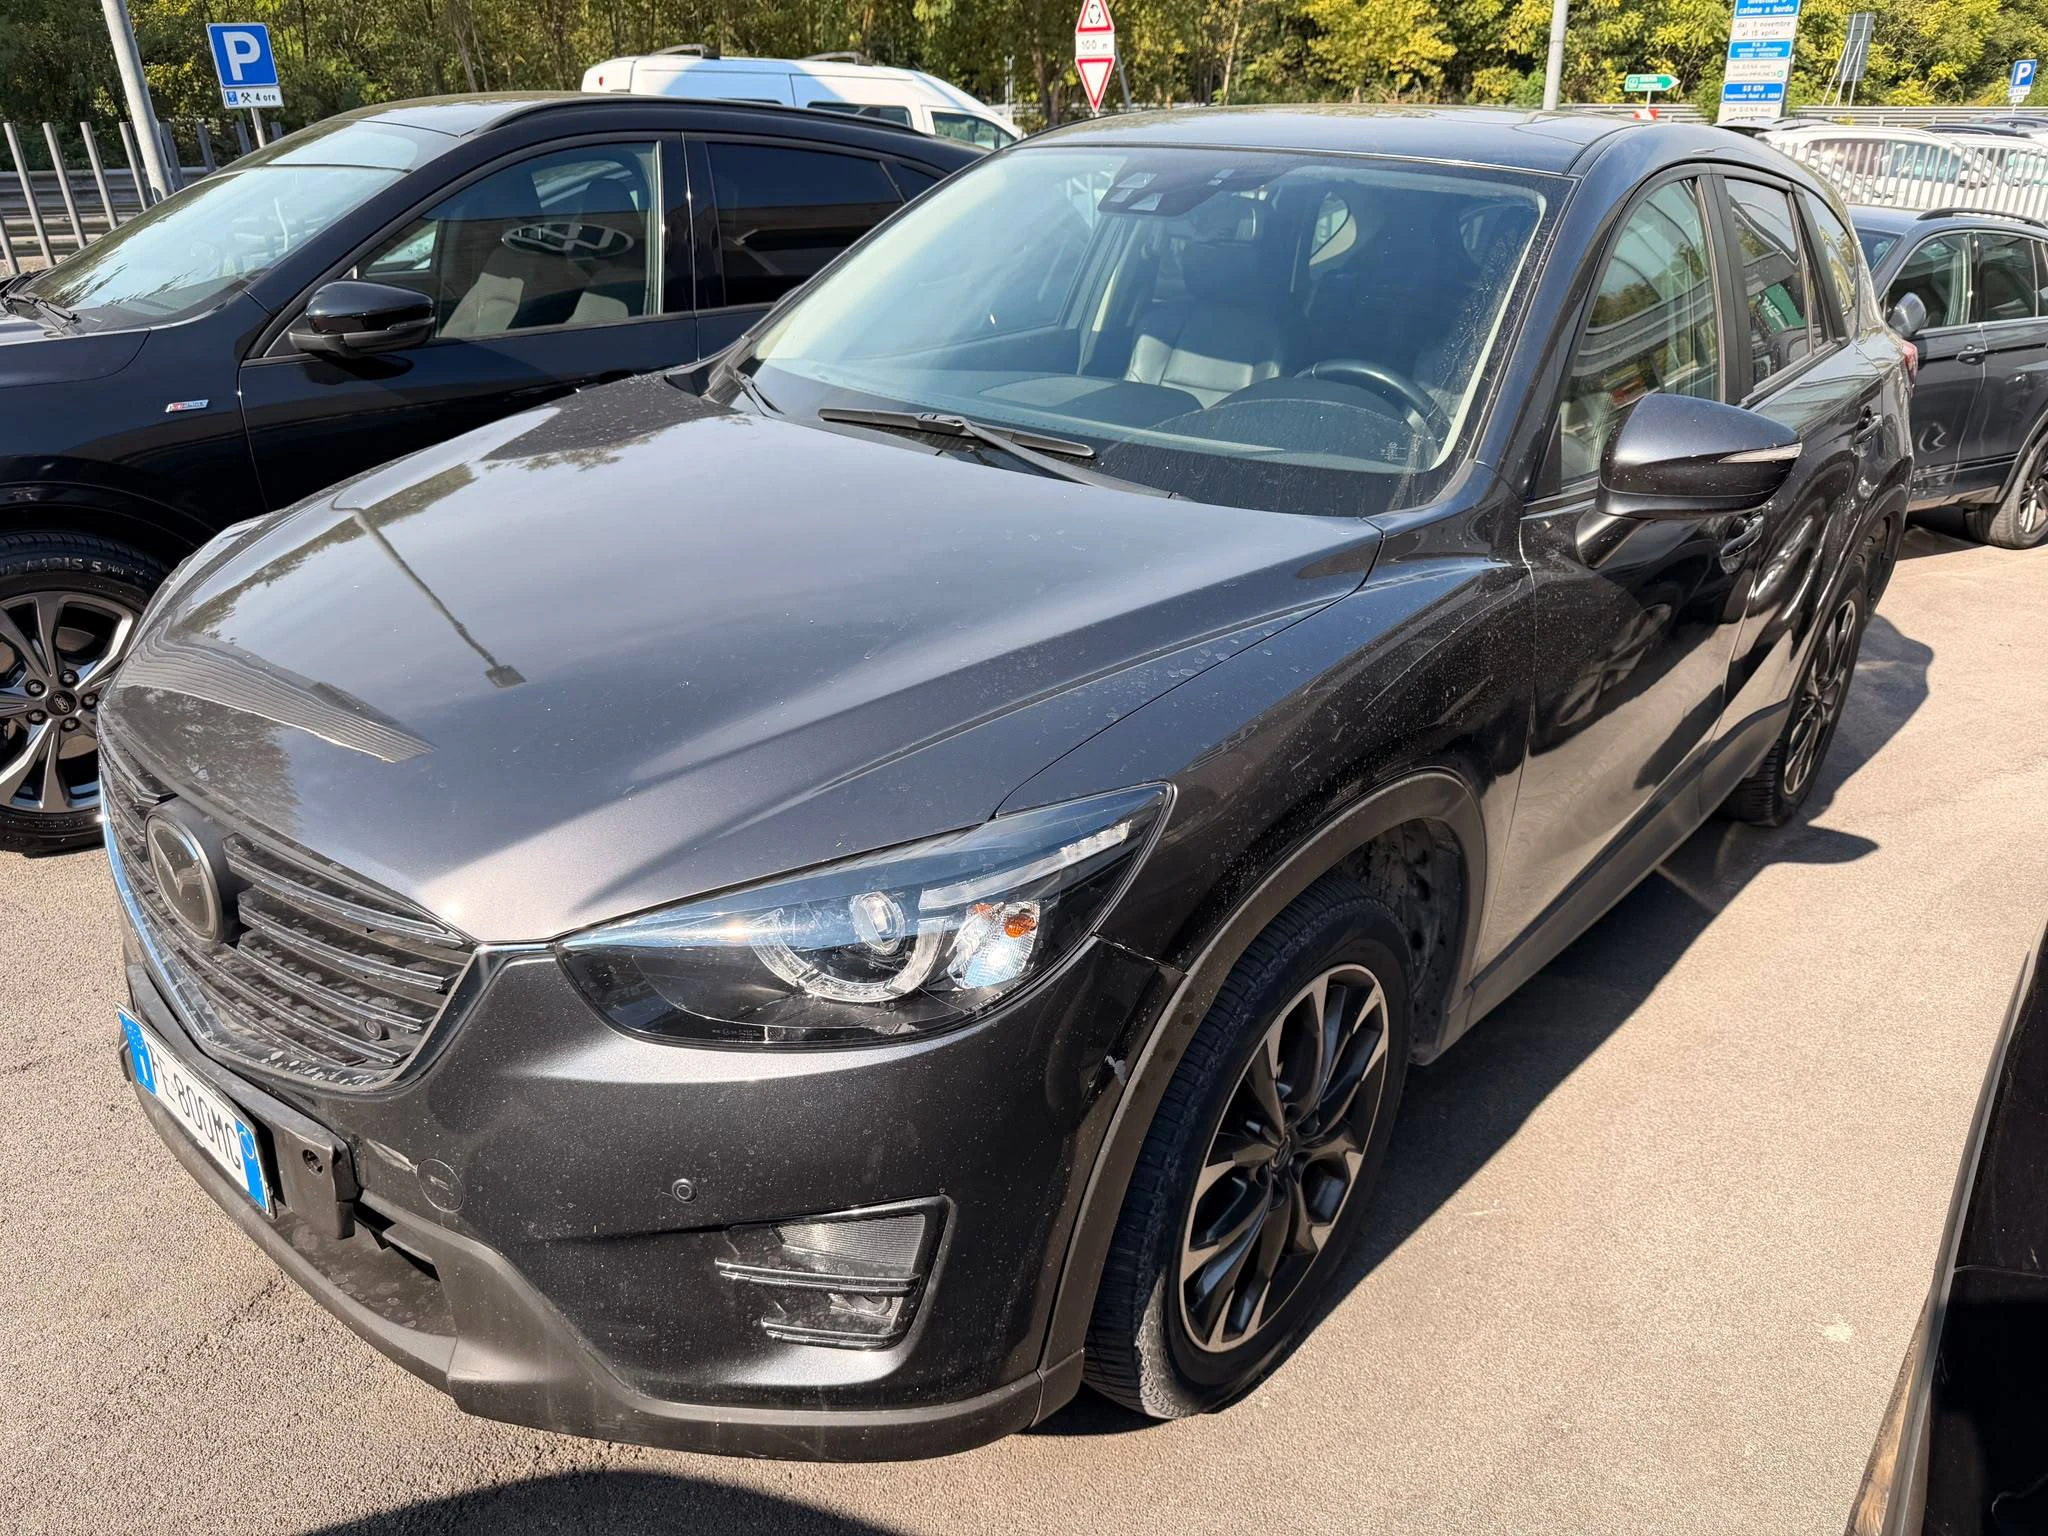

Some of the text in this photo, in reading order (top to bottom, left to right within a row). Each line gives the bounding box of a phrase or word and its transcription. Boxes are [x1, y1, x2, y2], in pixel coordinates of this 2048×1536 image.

[222, 31, 261, 80] P
[1081, 40, 1097, 50] 100
[2015, 63, 2031, 85] P
